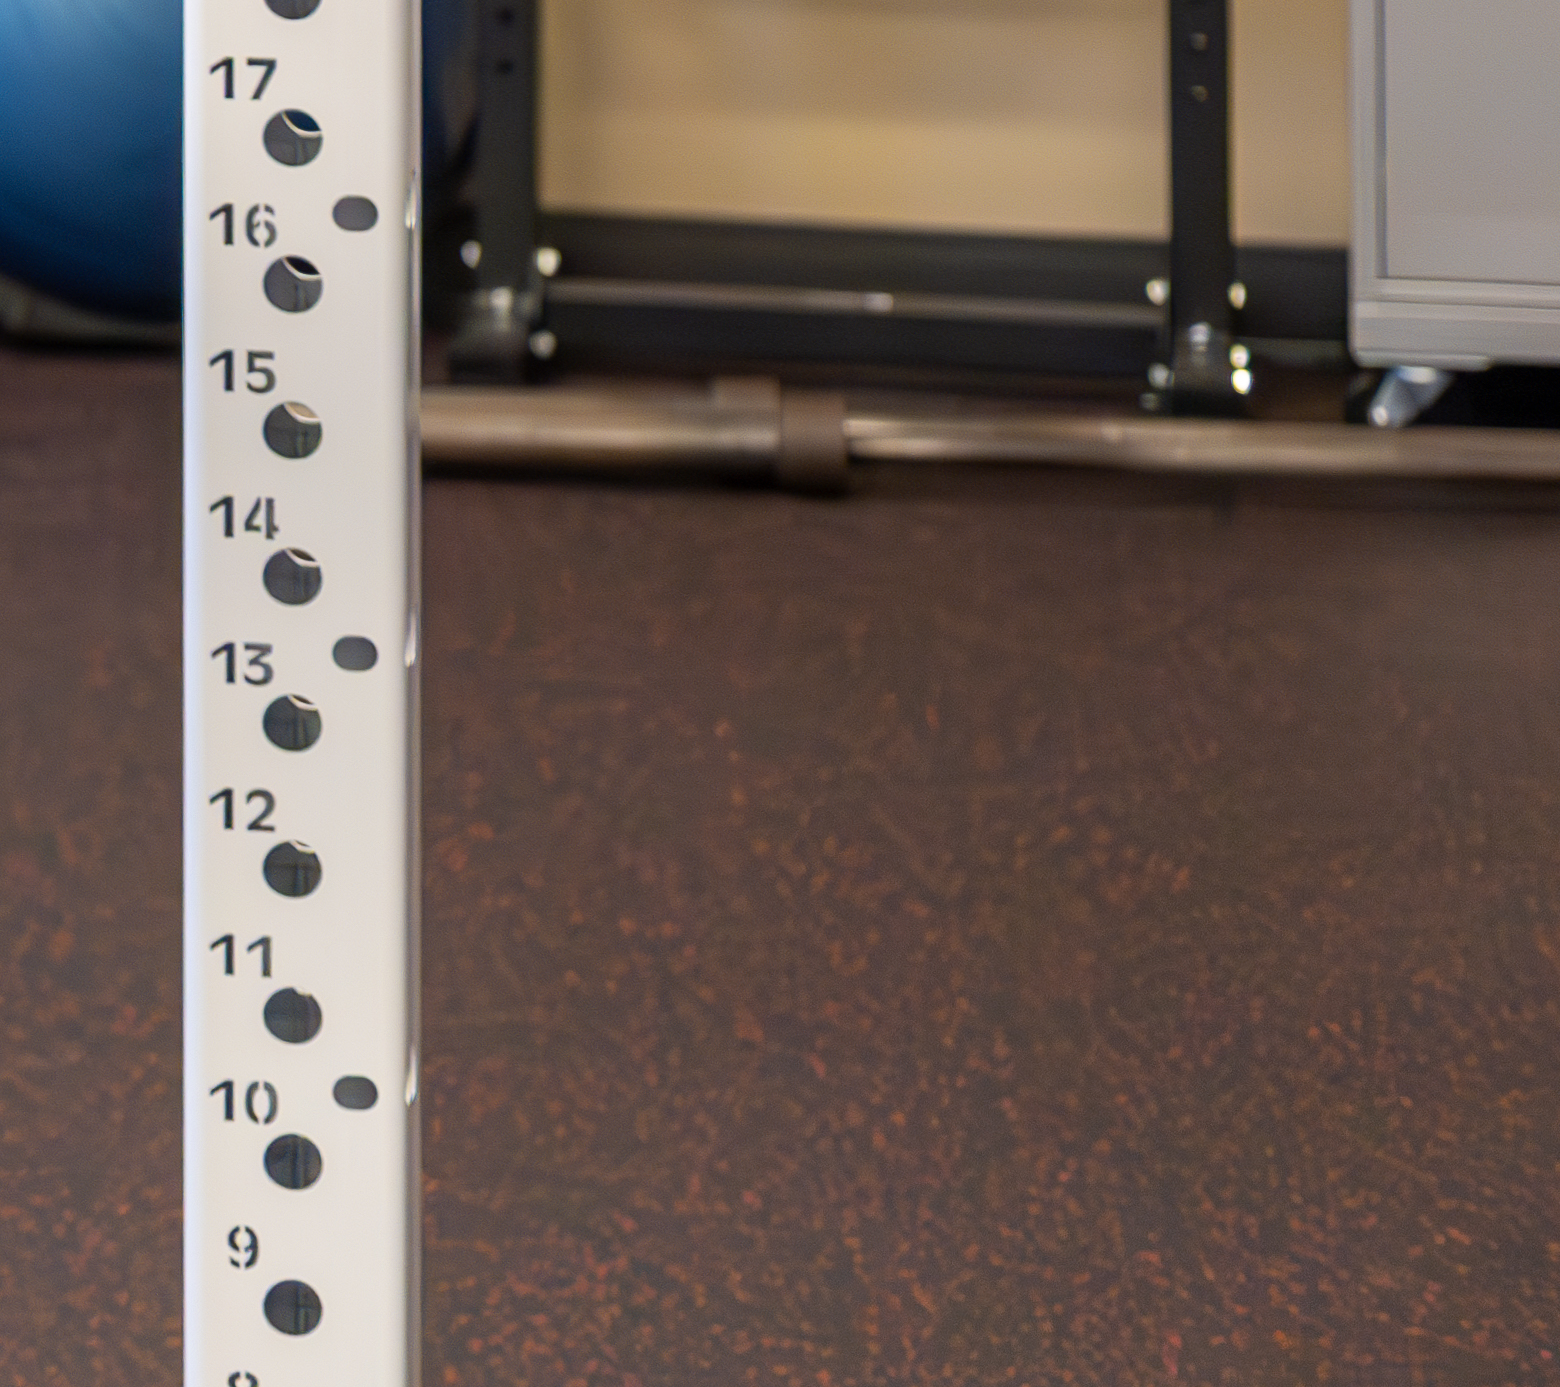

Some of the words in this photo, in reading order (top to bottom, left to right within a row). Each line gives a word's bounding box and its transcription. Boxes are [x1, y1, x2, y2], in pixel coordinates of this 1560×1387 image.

[208, 55, 278, 102] 17
[207, 201, 278, 249] 16
[207, 348, 277, 396] 15
[207, 494, 281, 542] 14
[209, 640, 275, 688] 13
[207, 786, 277, 834] 12
[208, 932, 273, 979] 11
[208, 1077, 280, 1126] 10
[226, 1224, 261, 1271] 9
